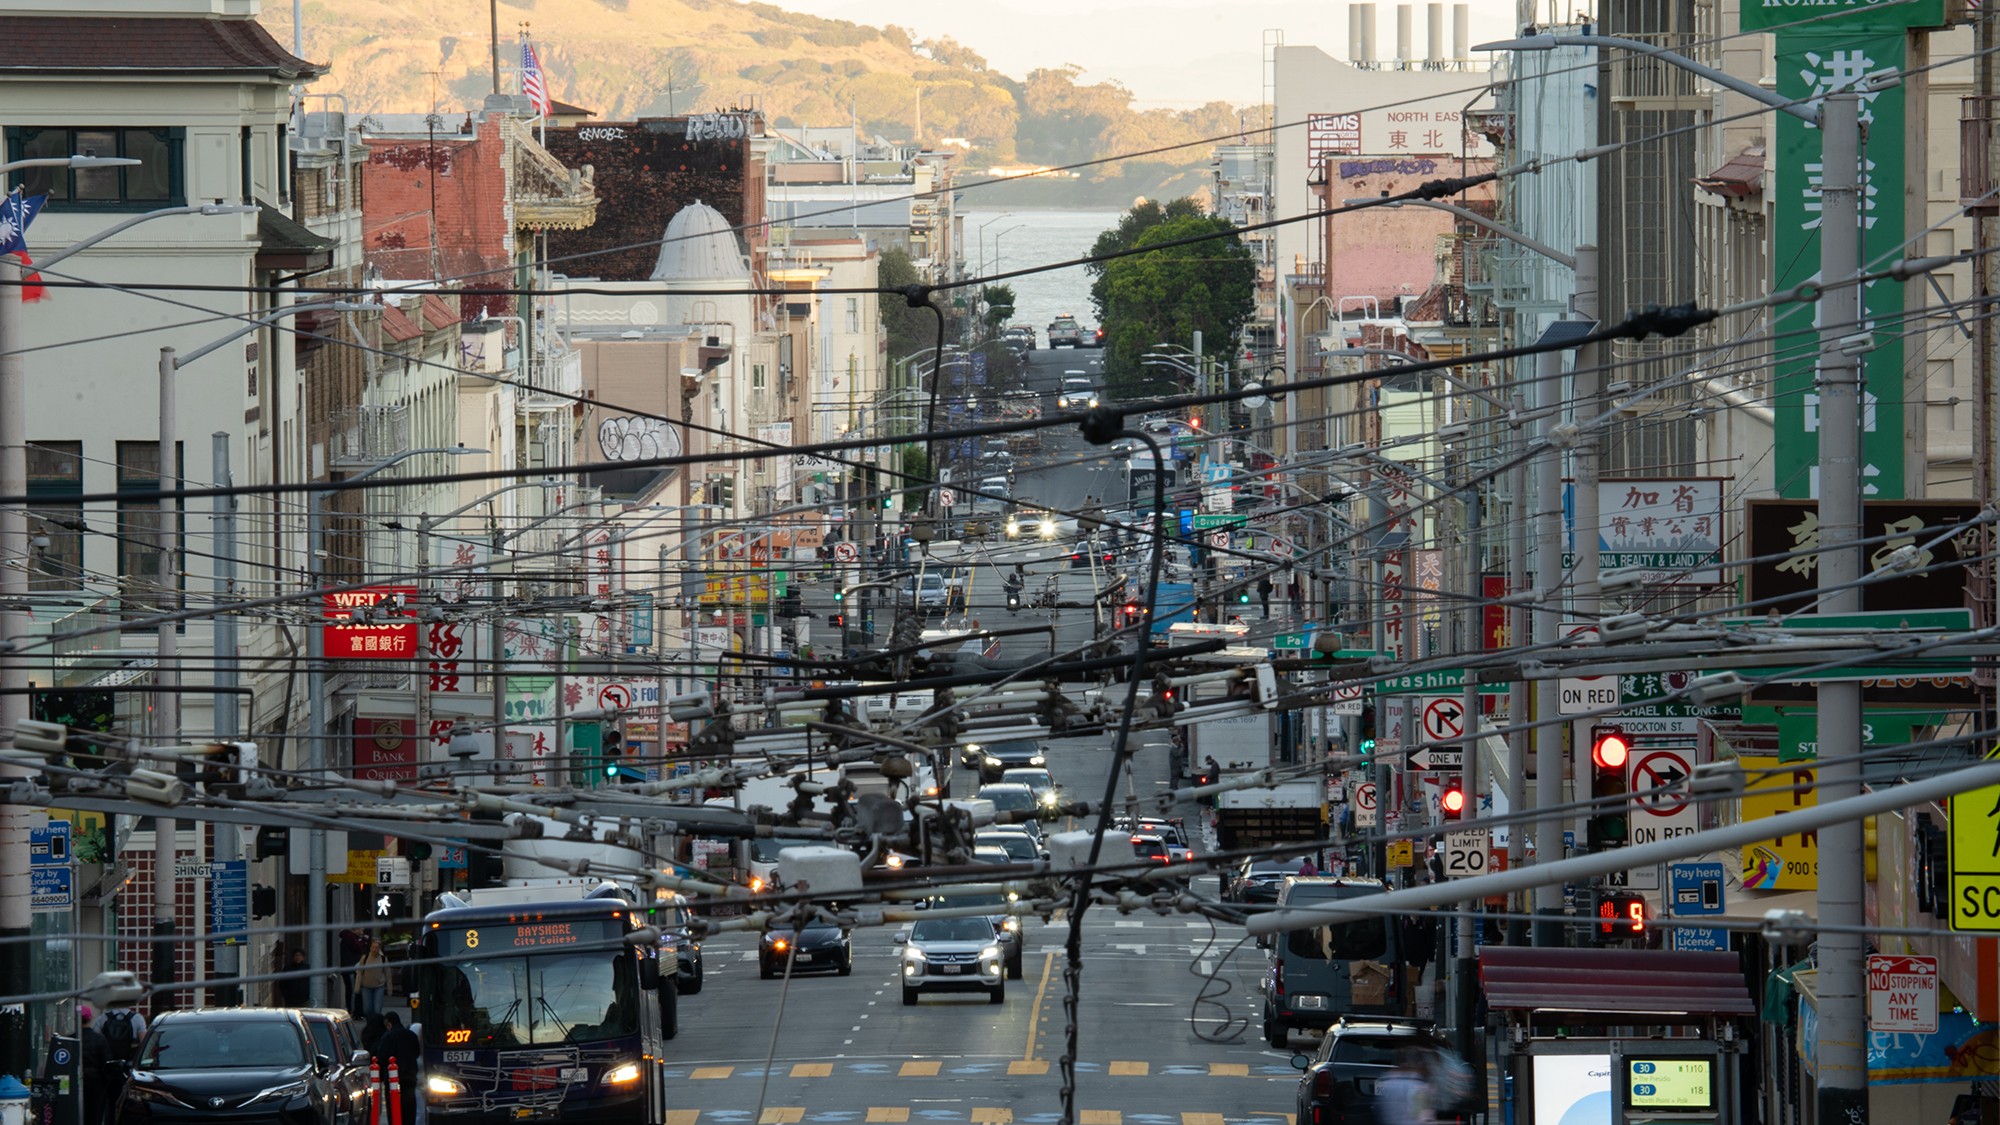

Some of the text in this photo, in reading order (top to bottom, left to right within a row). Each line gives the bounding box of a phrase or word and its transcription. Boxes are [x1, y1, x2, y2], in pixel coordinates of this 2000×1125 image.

[1309, 115, 1359, 131] NEMS
[1388, 112, 1429, 122] NORTH
[1620, 554, 1654, 567] REALTY
[1658, 555, 1665, 566] &
[1669, 555, 1695, 567] LAND
[350, 635, 407, 651] 富國銀行
[1563, 689, 1616, 704] ON RED
[1337, 703, 1361, 711] ON RED
[1666, 706, 1678, 716] K.
[1684, 705, 1717, 716] TONG
[1620, 722, 1667, 732] STOCKTON
[372, 750, 405, 763] BANK
[1429, 754, 1450, 763] ONE
[366, 769, 411, 781] ORIENT
[47, 826, 67, 834] here
[1448, 826, 1485, 836] SPEED
[1635, 827, 1656, 844] ON
[1452, 839, 1481, 848] LIMIT
[1449, 850, 1484, 870] 20
[47, 870, 58, 878] by
[1675, 868, 1721, 880] Pay here
[1787, 861, 1809, 876] 900
[1630, 902, 1643, 931] 9
[517, 924, 571, 937] BAYSHORE
[1678, 927, 1712, 938] Pay by
[466, 929, 479, 949] 8
[514, 937, 535, 946] City
[1678, 937, 1716, 947] License
[1872, 973, 1934, 990] NO STOPPING
[1888, 993, 1919, 1005] ANY
[1889, 1007, 1919, 1021] TIME
[446, 1029, 472, 1043] 207
[446, 1051, 472, 1062] 6517
[1639, 1063, 1650, 1073] 30
[1639, 1085, 1650, 1095] 30
